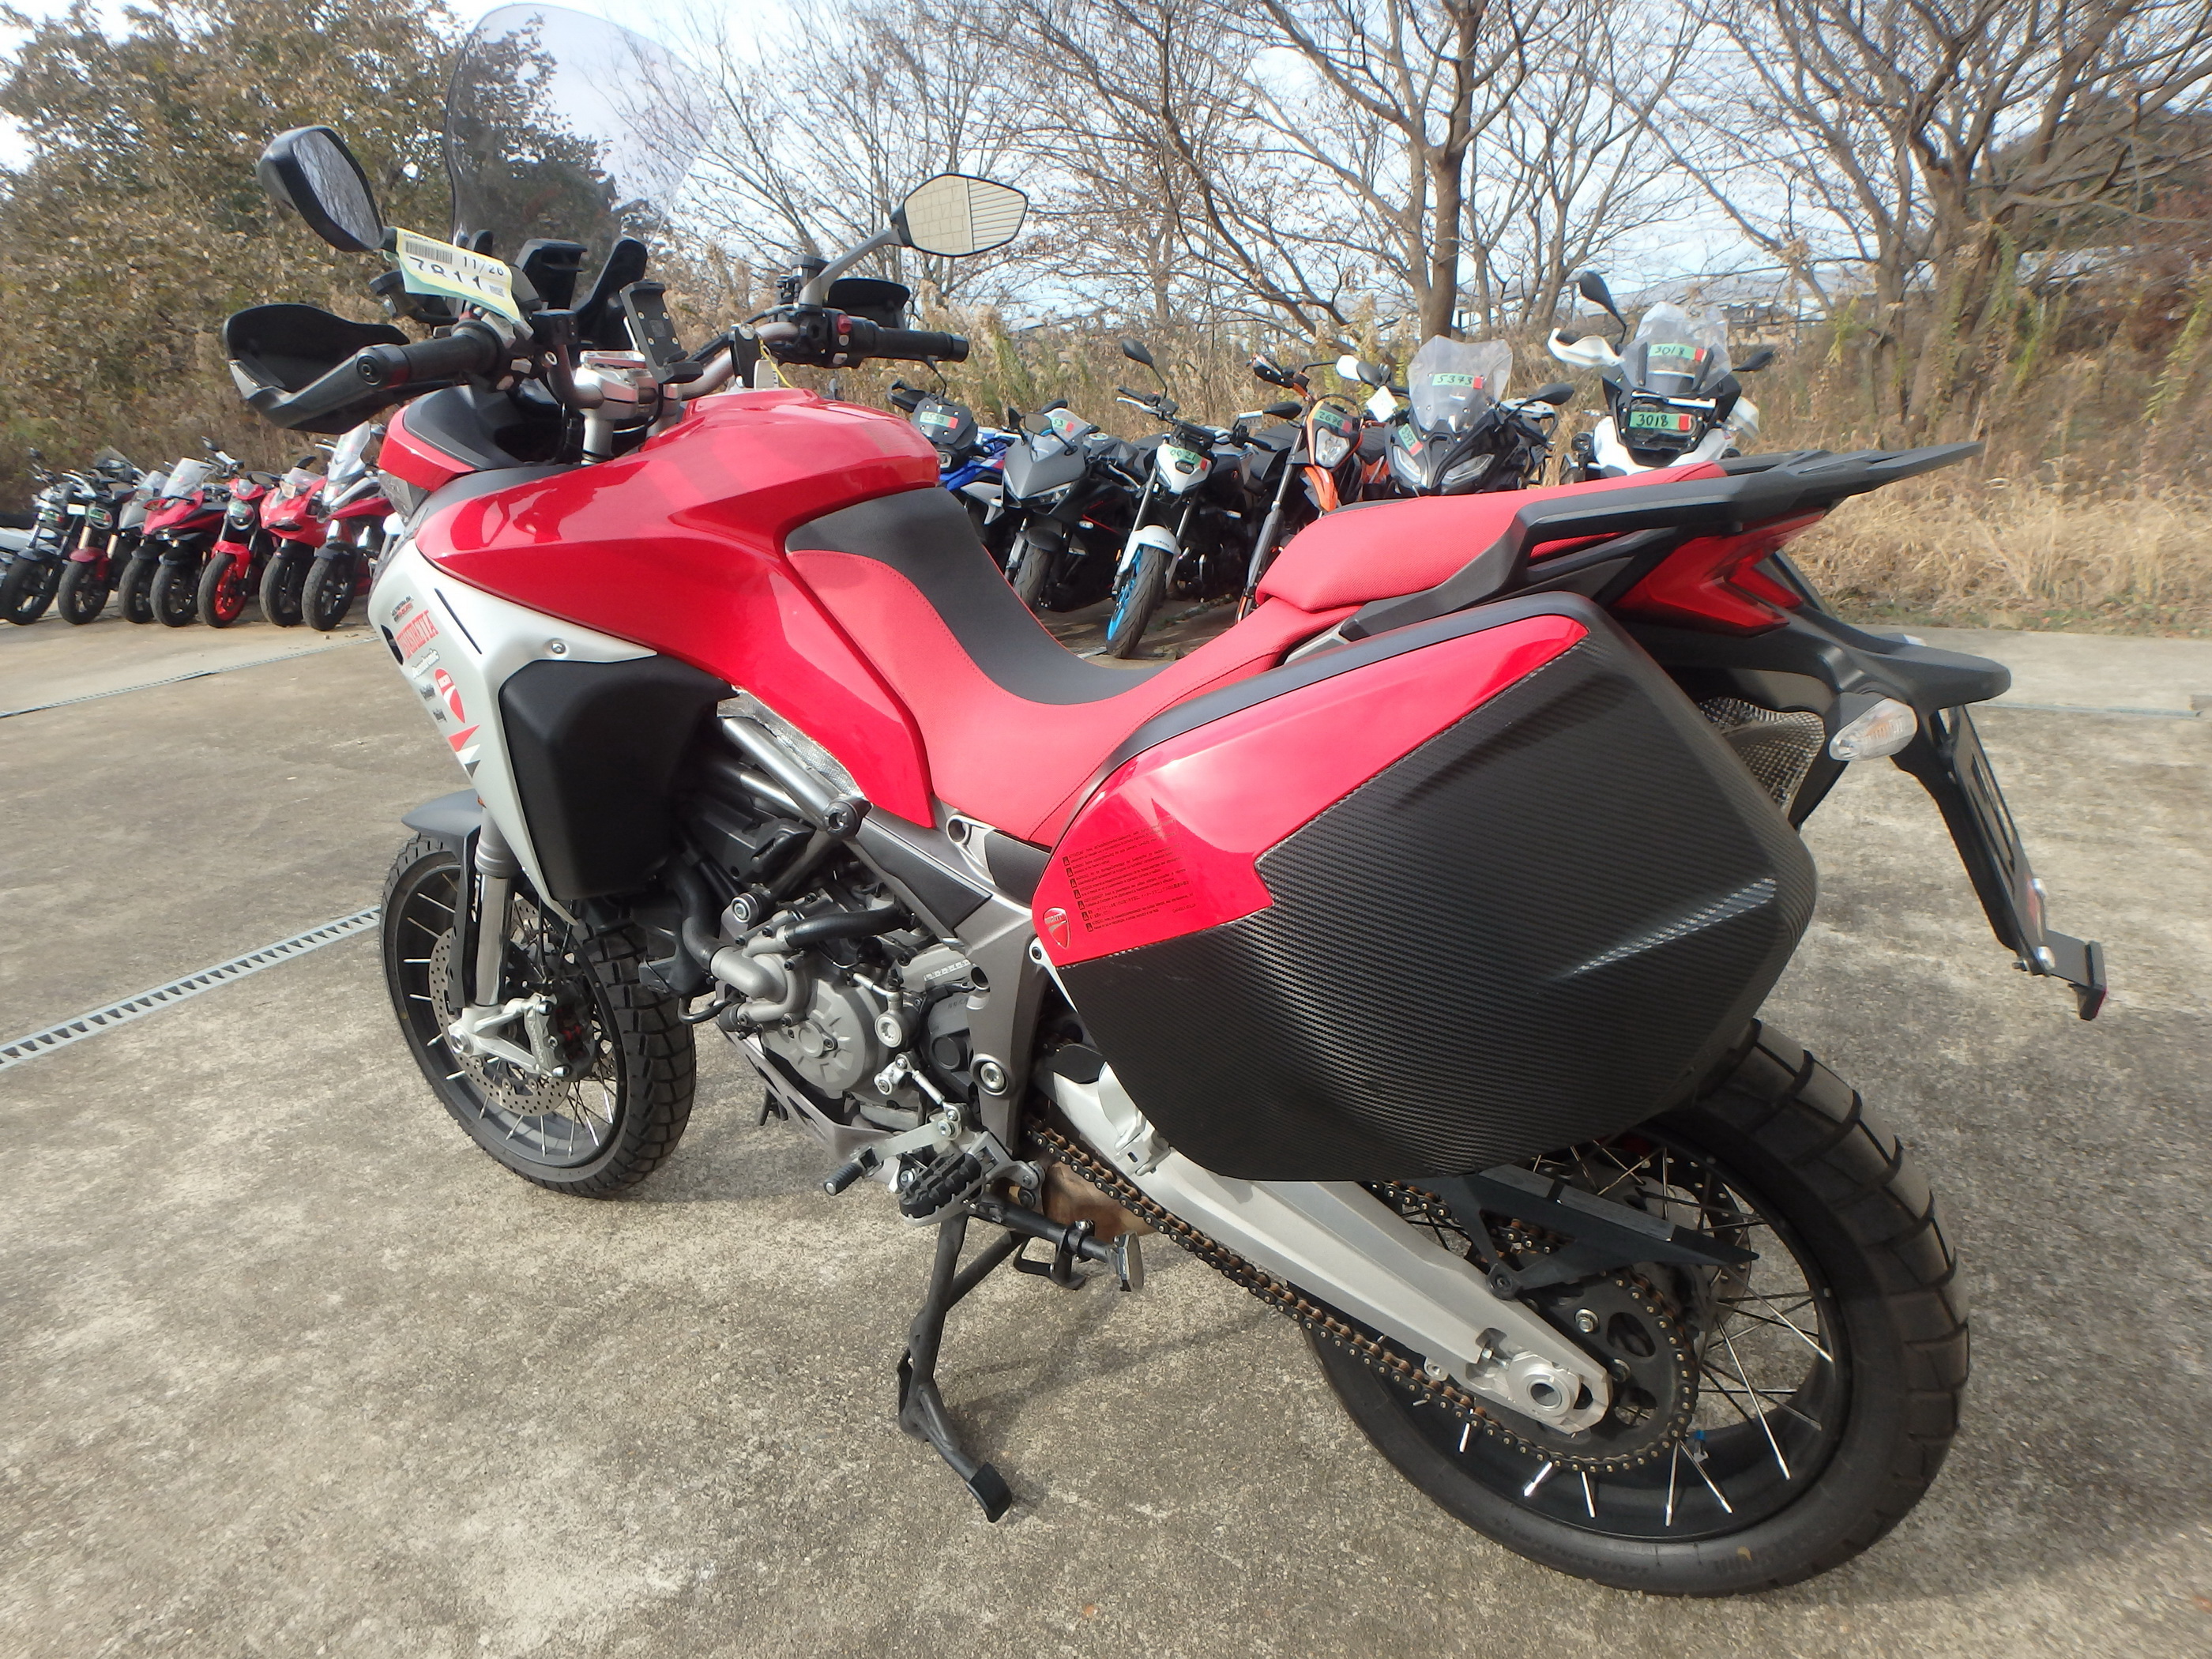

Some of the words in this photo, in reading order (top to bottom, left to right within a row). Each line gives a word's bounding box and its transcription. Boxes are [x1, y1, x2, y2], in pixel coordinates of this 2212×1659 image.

[1654, 346, 1685, 355] 3018
[1437, 374, 1473, 385] 5373
[1319, 411, 1343, 426] 2676
[1636, 414, 1668, 427] 3018
